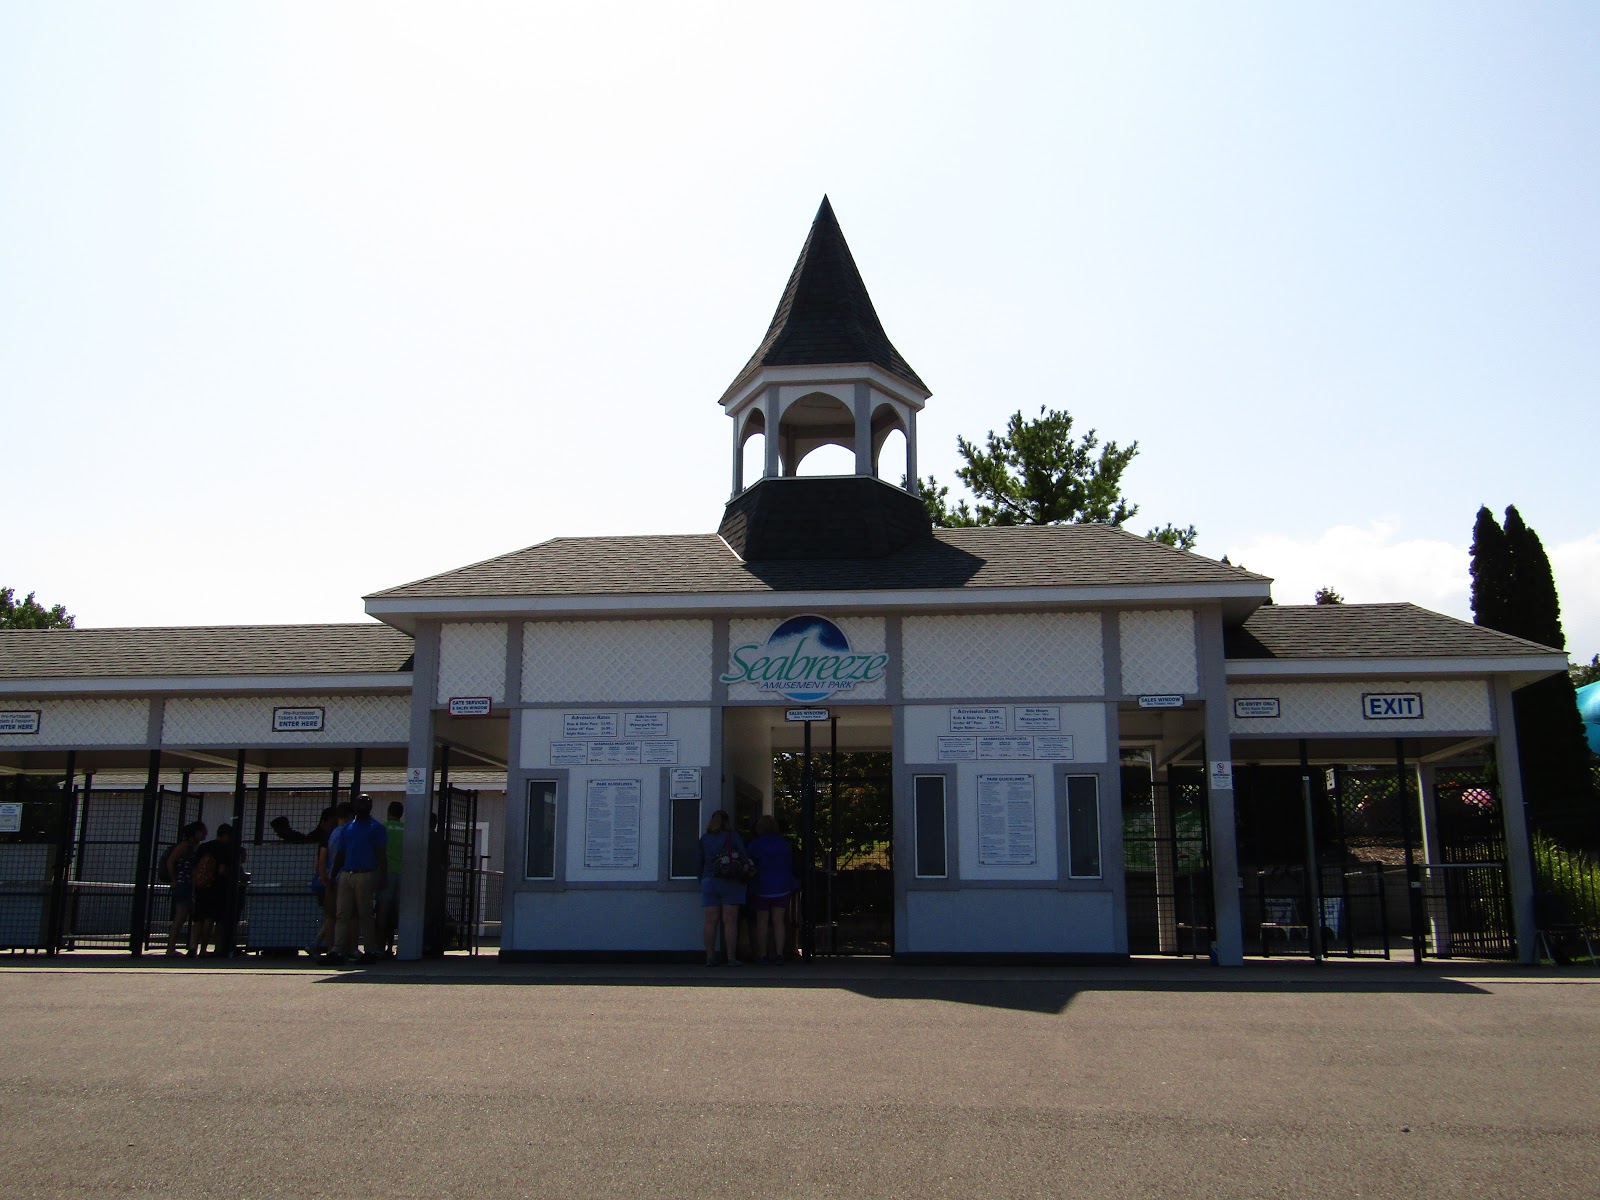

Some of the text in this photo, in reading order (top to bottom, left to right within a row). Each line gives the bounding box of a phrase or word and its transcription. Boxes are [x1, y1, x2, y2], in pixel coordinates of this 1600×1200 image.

[721, 636, 888, 681] Seabreeze
[761, 680, 854, 689] AMUSEMENT PARK
[1369, 697, 1416, 715] EXIT
